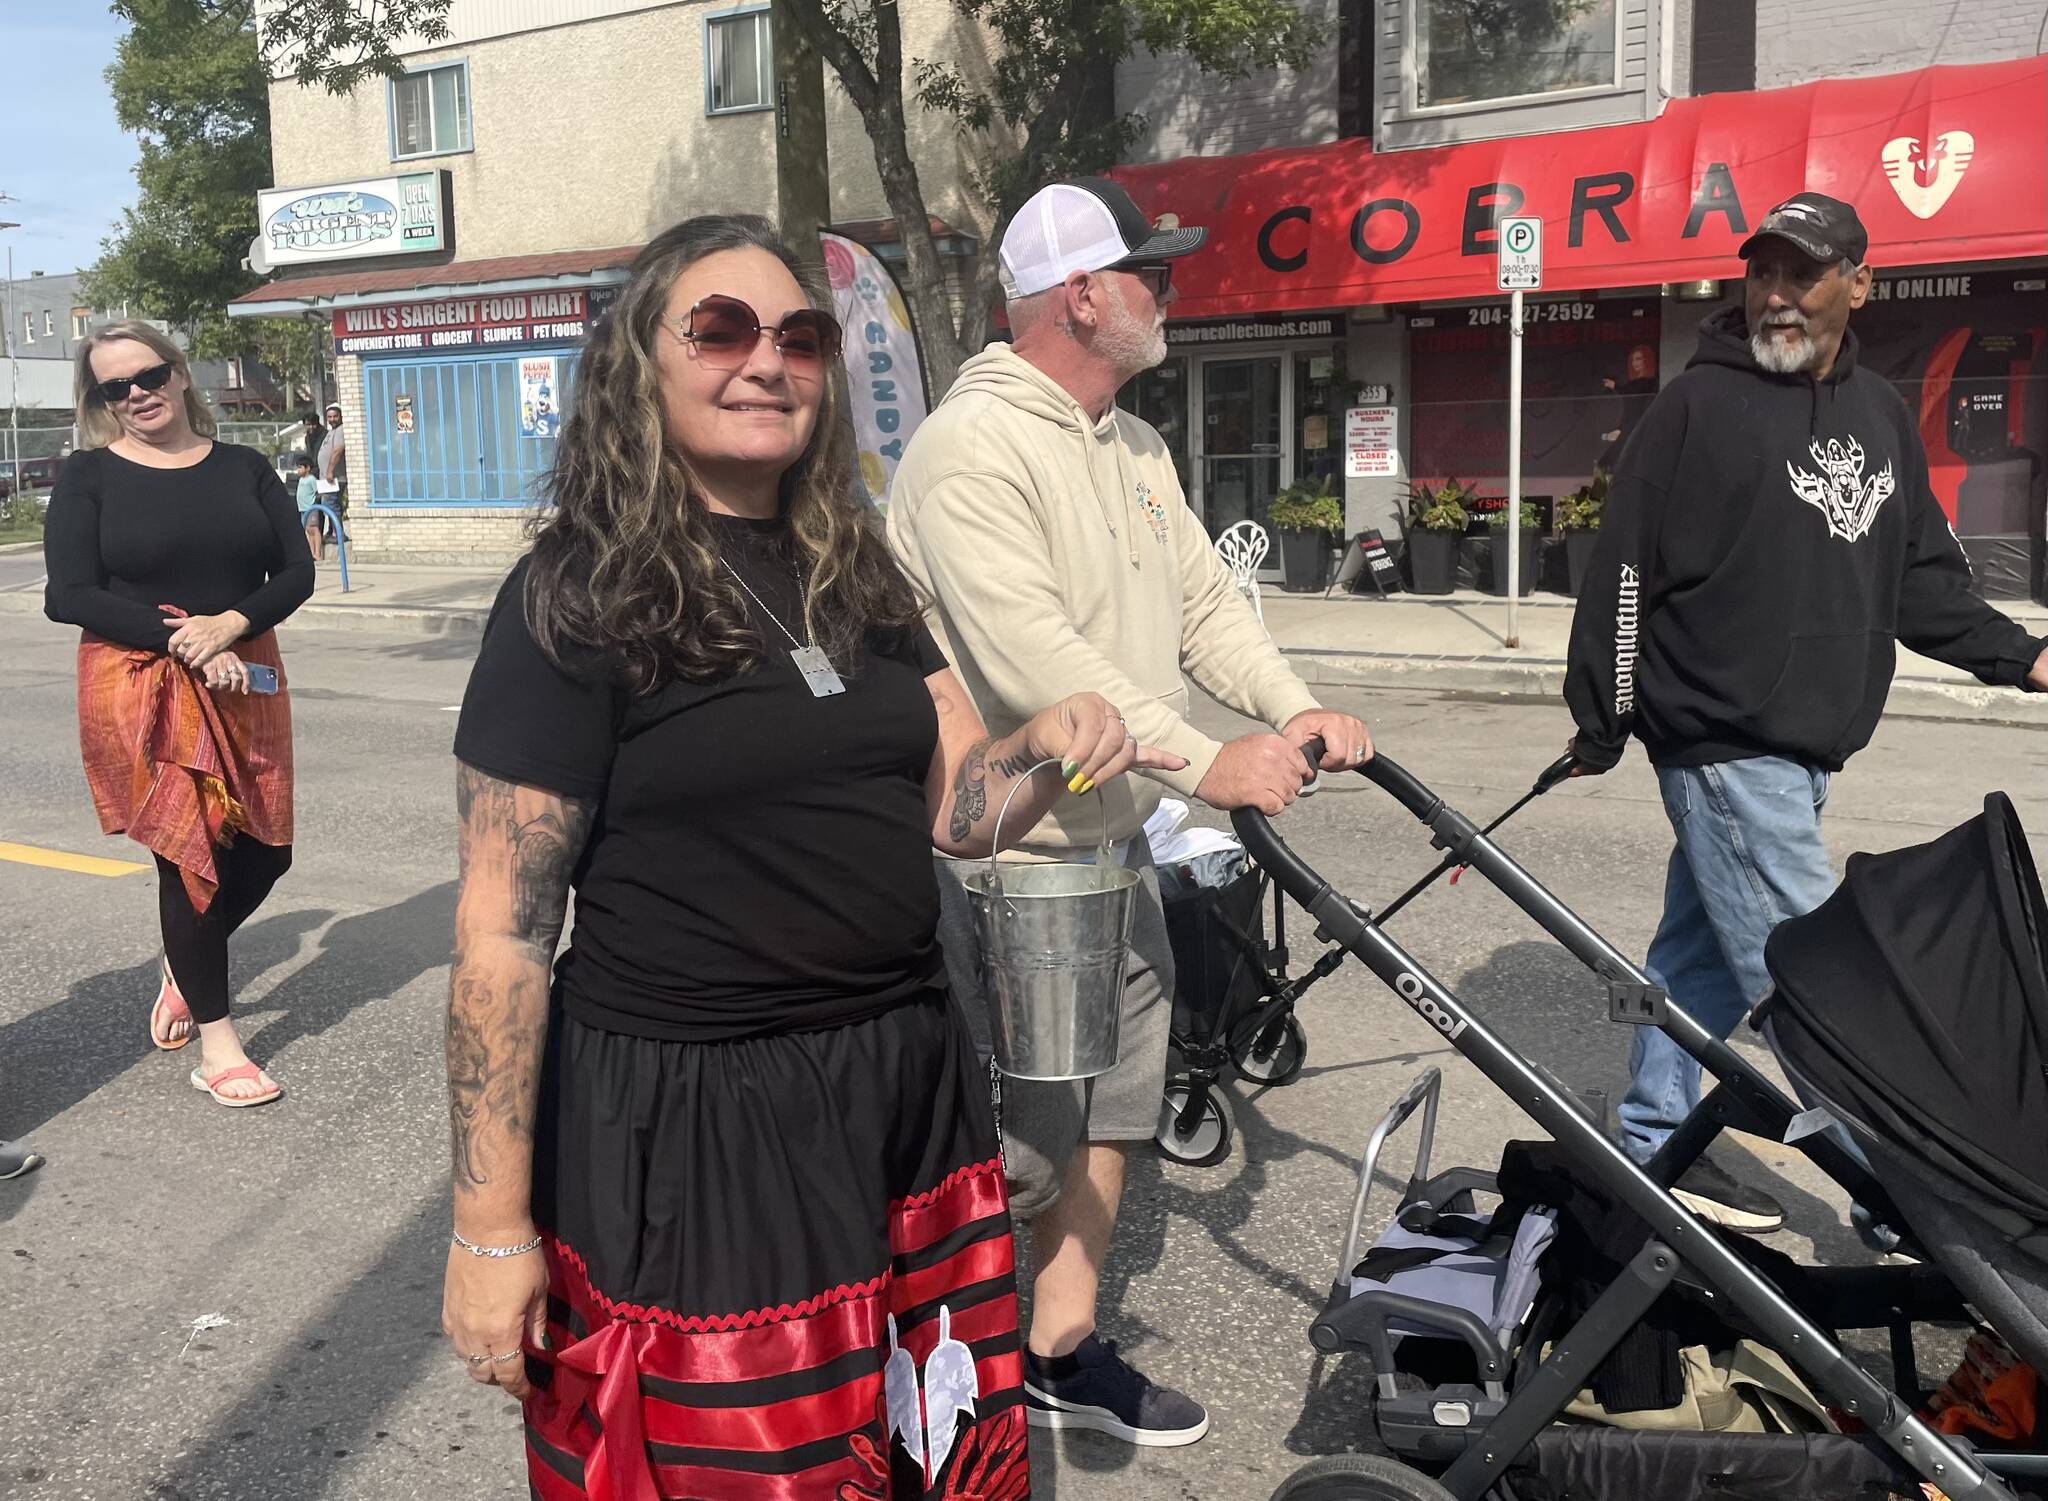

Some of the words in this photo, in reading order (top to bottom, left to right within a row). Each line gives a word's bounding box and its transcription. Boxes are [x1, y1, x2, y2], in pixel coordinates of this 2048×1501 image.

[405, 184, 431, 205] OPEN
[271, 210, 392, 236] SARGENT
[402, 207, 408, 226] 7
[411, 205, 435, 225] DAYS
[1256, 162, 1749, 273] COBRA
[273, 222, 393, 250] FOODS
[405, 230, 411, 238] A
[411, 227, 433, 237] WEEK
[1515, 229, 1527, 246] P
[1867, 281, 1892, 301] EN
[1896, 276, 1972, 299] ONLINE
[345, 307, 399, 332] WILL'S
[401, 300, 478, 328] SARGENT
[481, 297, 527, 322] FOOD
[530, 292, 582, 318] MART
[1468, 303, 1596, 326] 204-27-2592
[342, 338, 394, 352] CONVENIENT
[394, 333, 423, 349] STORE
[431, 329, 473, 346] GROCERY
[483, 326, 523, 342] SLURPEE
[533, 324, 550, 339] PET
[551, 321, 584, 337] FOODS
[865, 320, 903, 462] CANDY
[1973, 394, 2004, 402] GAME
[1973, 402, 2003, 411] OVER
[1355, 452, 1388, 460] CLOSED
[1614, 563, 1640, 715] Amphibious
